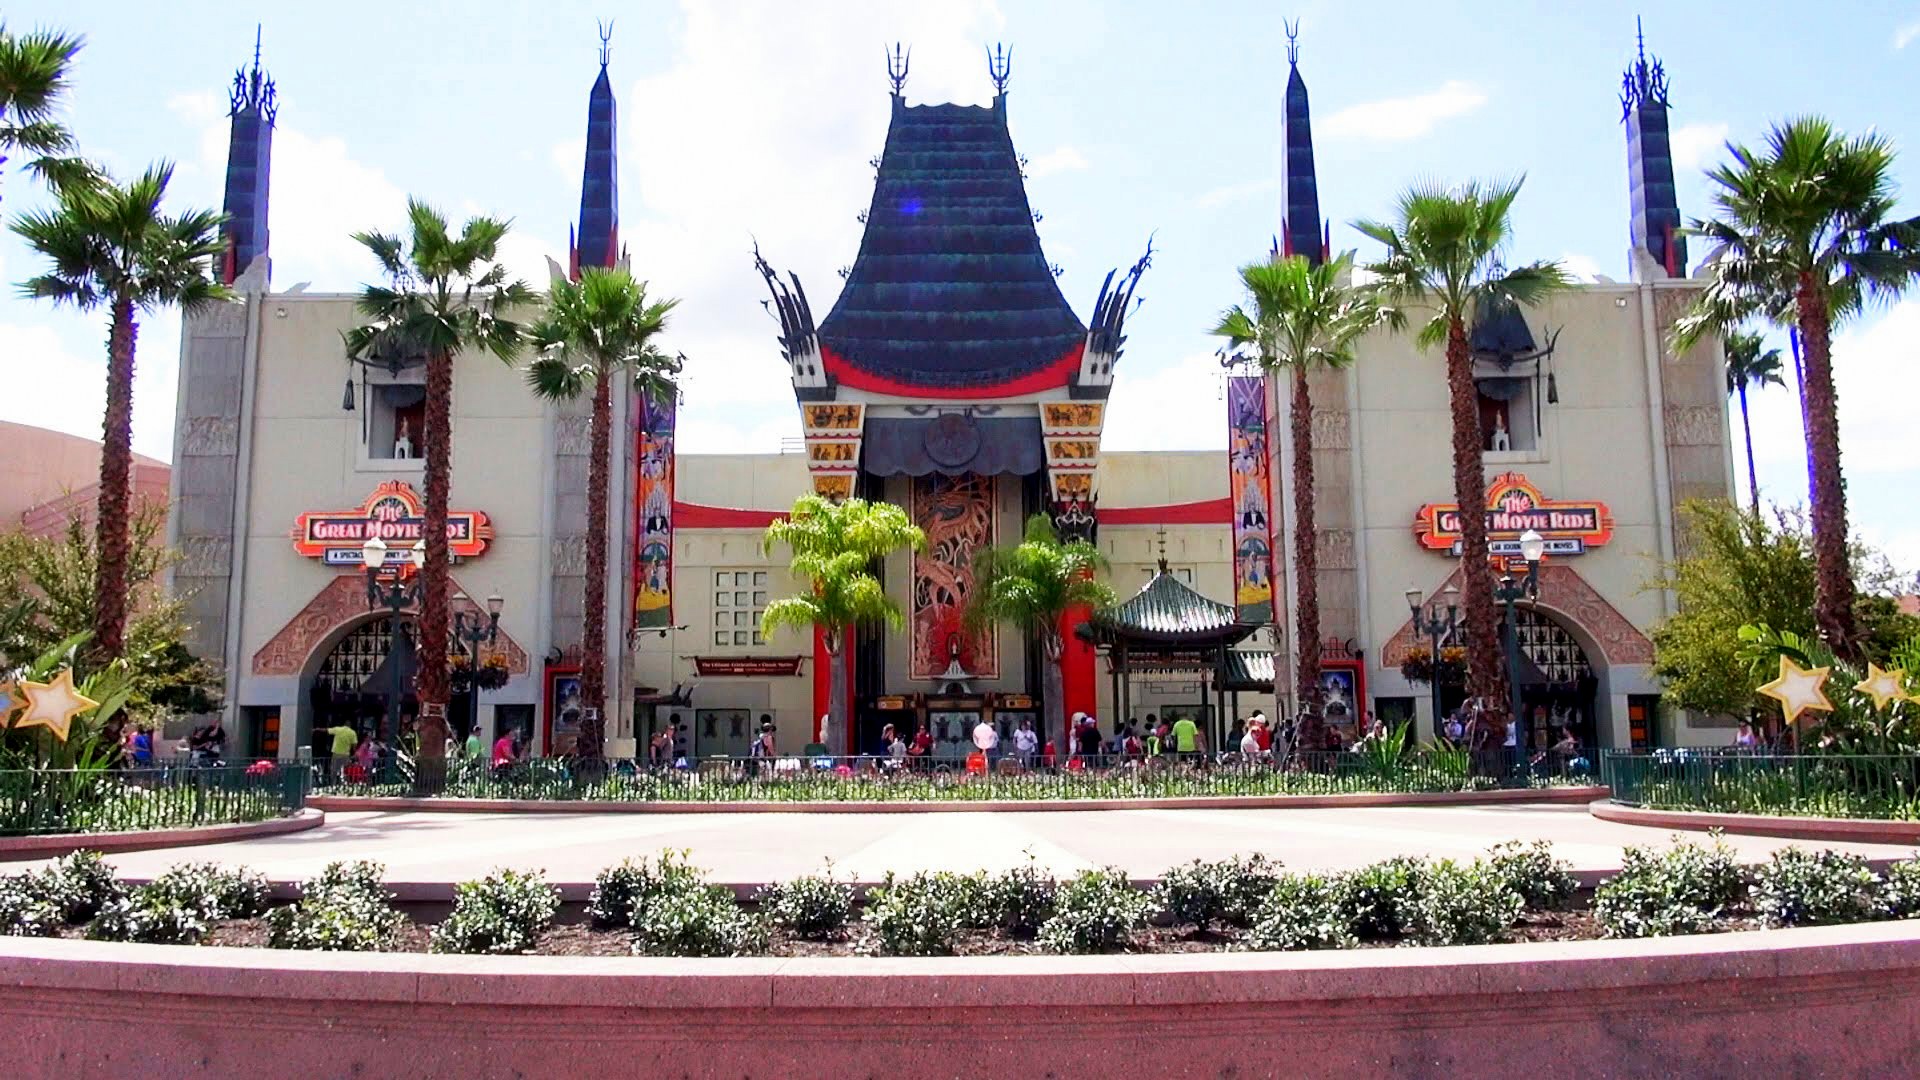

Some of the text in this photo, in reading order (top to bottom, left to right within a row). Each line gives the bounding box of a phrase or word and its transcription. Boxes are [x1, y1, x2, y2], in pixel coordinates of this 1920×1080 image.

[1502, 496, 1529, 512] The
[374, 506, 404, 521] The
[1493, 513, 1548, 530] MOVIE
[1551, 512, 1594, 529] RIDE
[313, 520, 362, 538] GREAT
[365, 521, 420, 538] MOVIE
